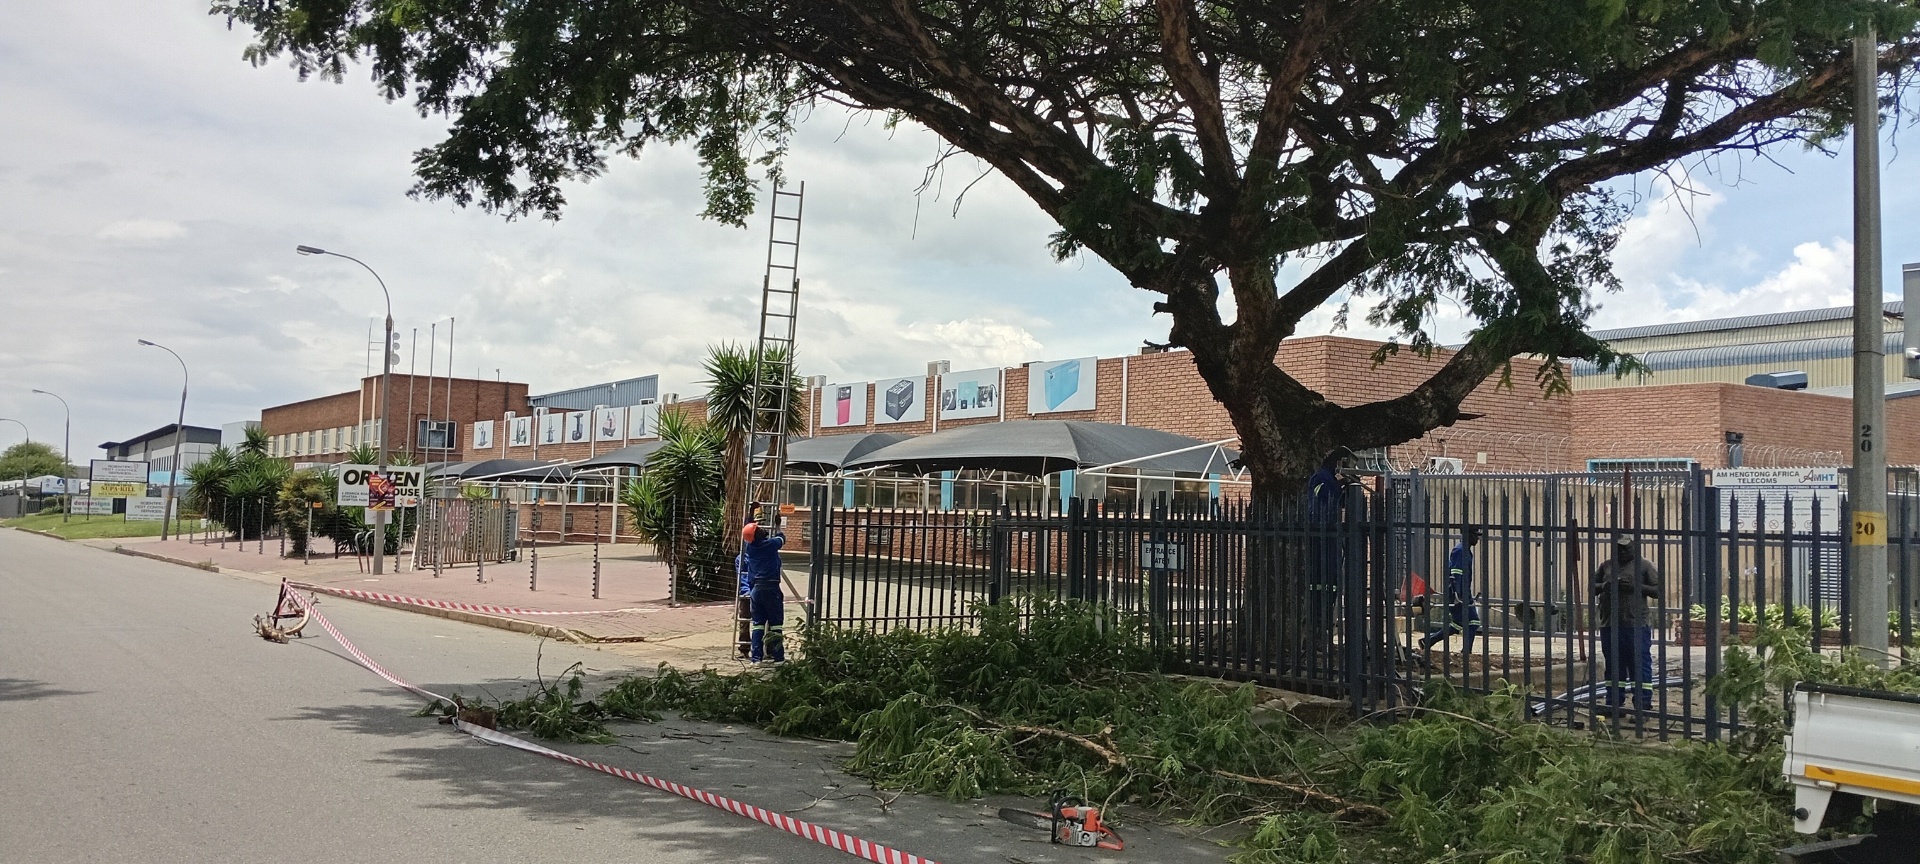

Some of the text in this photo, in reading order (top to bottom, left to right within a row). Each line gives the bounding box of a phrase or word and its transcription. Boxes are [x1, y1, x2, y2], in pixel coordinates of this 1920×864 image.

[343, 469, 420, 487] OREN
[1799, 469, 1835, 483] AMHT
[394, 488, 420, 496] OUSE
[1856, 522, 1875, 535] 20
